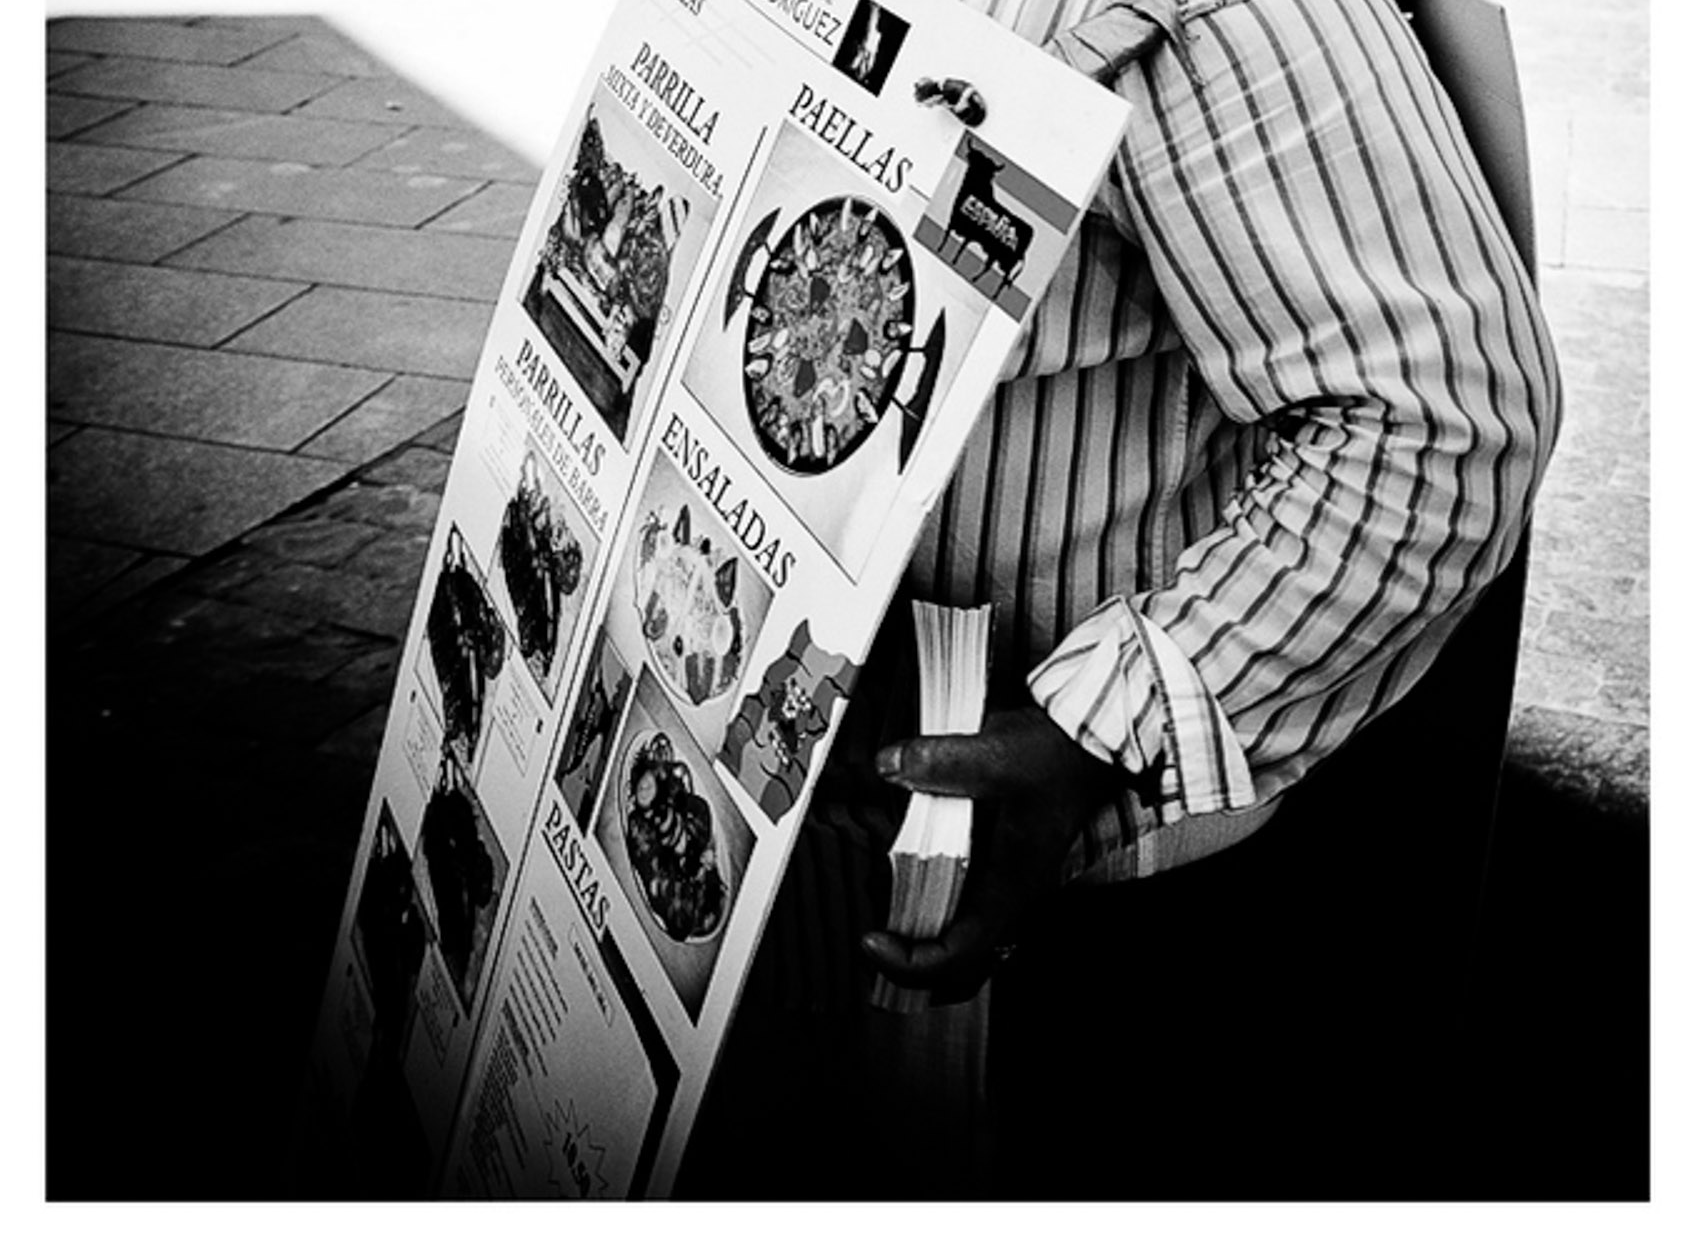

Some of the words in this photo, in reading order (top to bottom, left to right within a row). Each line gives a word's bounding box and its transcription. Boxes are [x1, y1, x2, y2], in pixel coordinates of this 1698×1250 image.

[630, 41, 719, 146] PARRILLA
[788, 82, 914, 193] PAELLAS
[516, 337, 607, 476] PARRILLAS
[569, 466, 608, 533] BARRA
[661, 411, 797, 588] ENSALADAS
[545, 799, 611, 931] PASTAS
